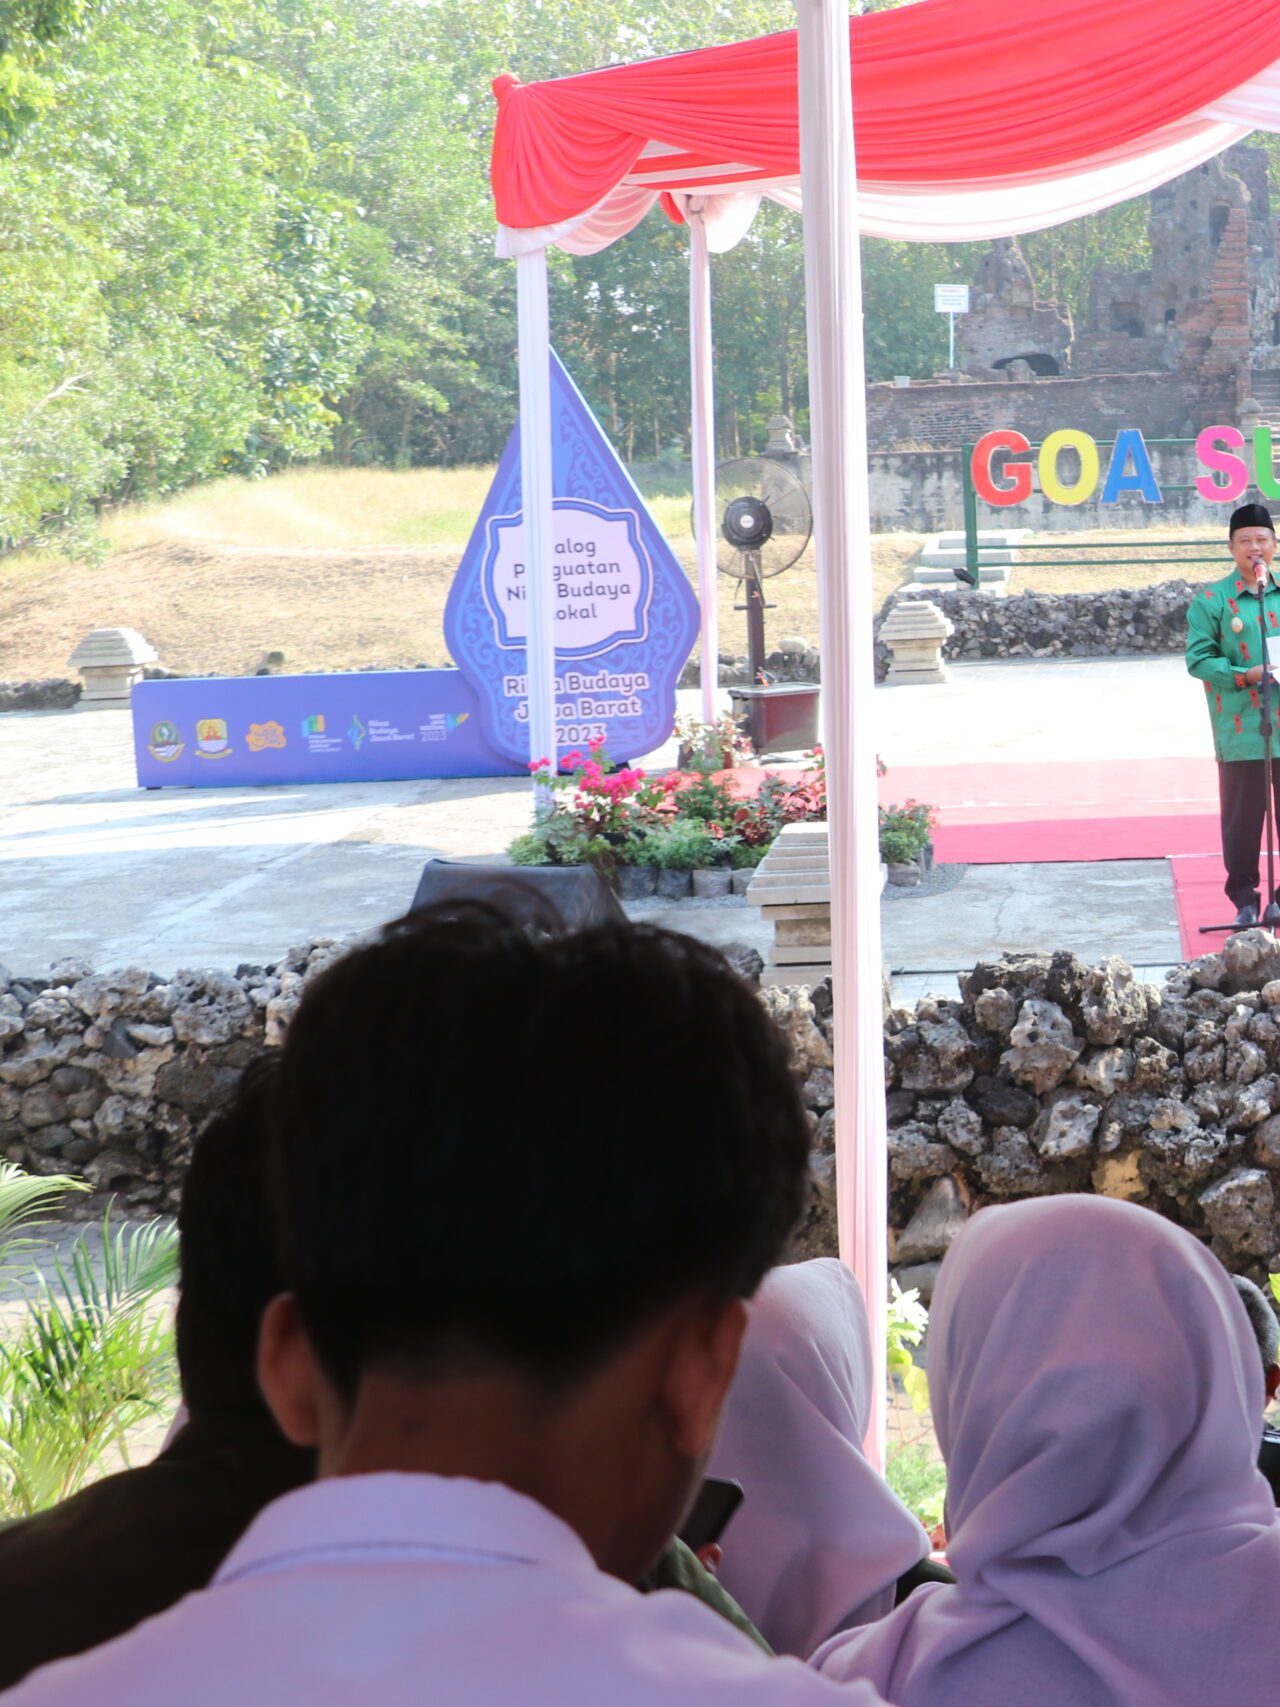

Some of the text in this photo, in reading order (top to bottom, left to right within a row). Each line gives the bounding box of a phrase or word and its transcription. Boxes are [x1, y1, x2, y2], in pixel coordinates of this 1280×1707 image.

[970, 429, 1164, 507] GOA
[554, 538, 597, 557] alog
[513, 561, 621, 582] Pguatan
[557, 580, 632, 600] Budaya
[552, 603, 598, 620] okal
[506, 672, 647, 695] Ria Budaya
[517, 699, 640, 720] Ja Barat
[555, 725, 605, 744] 2023
